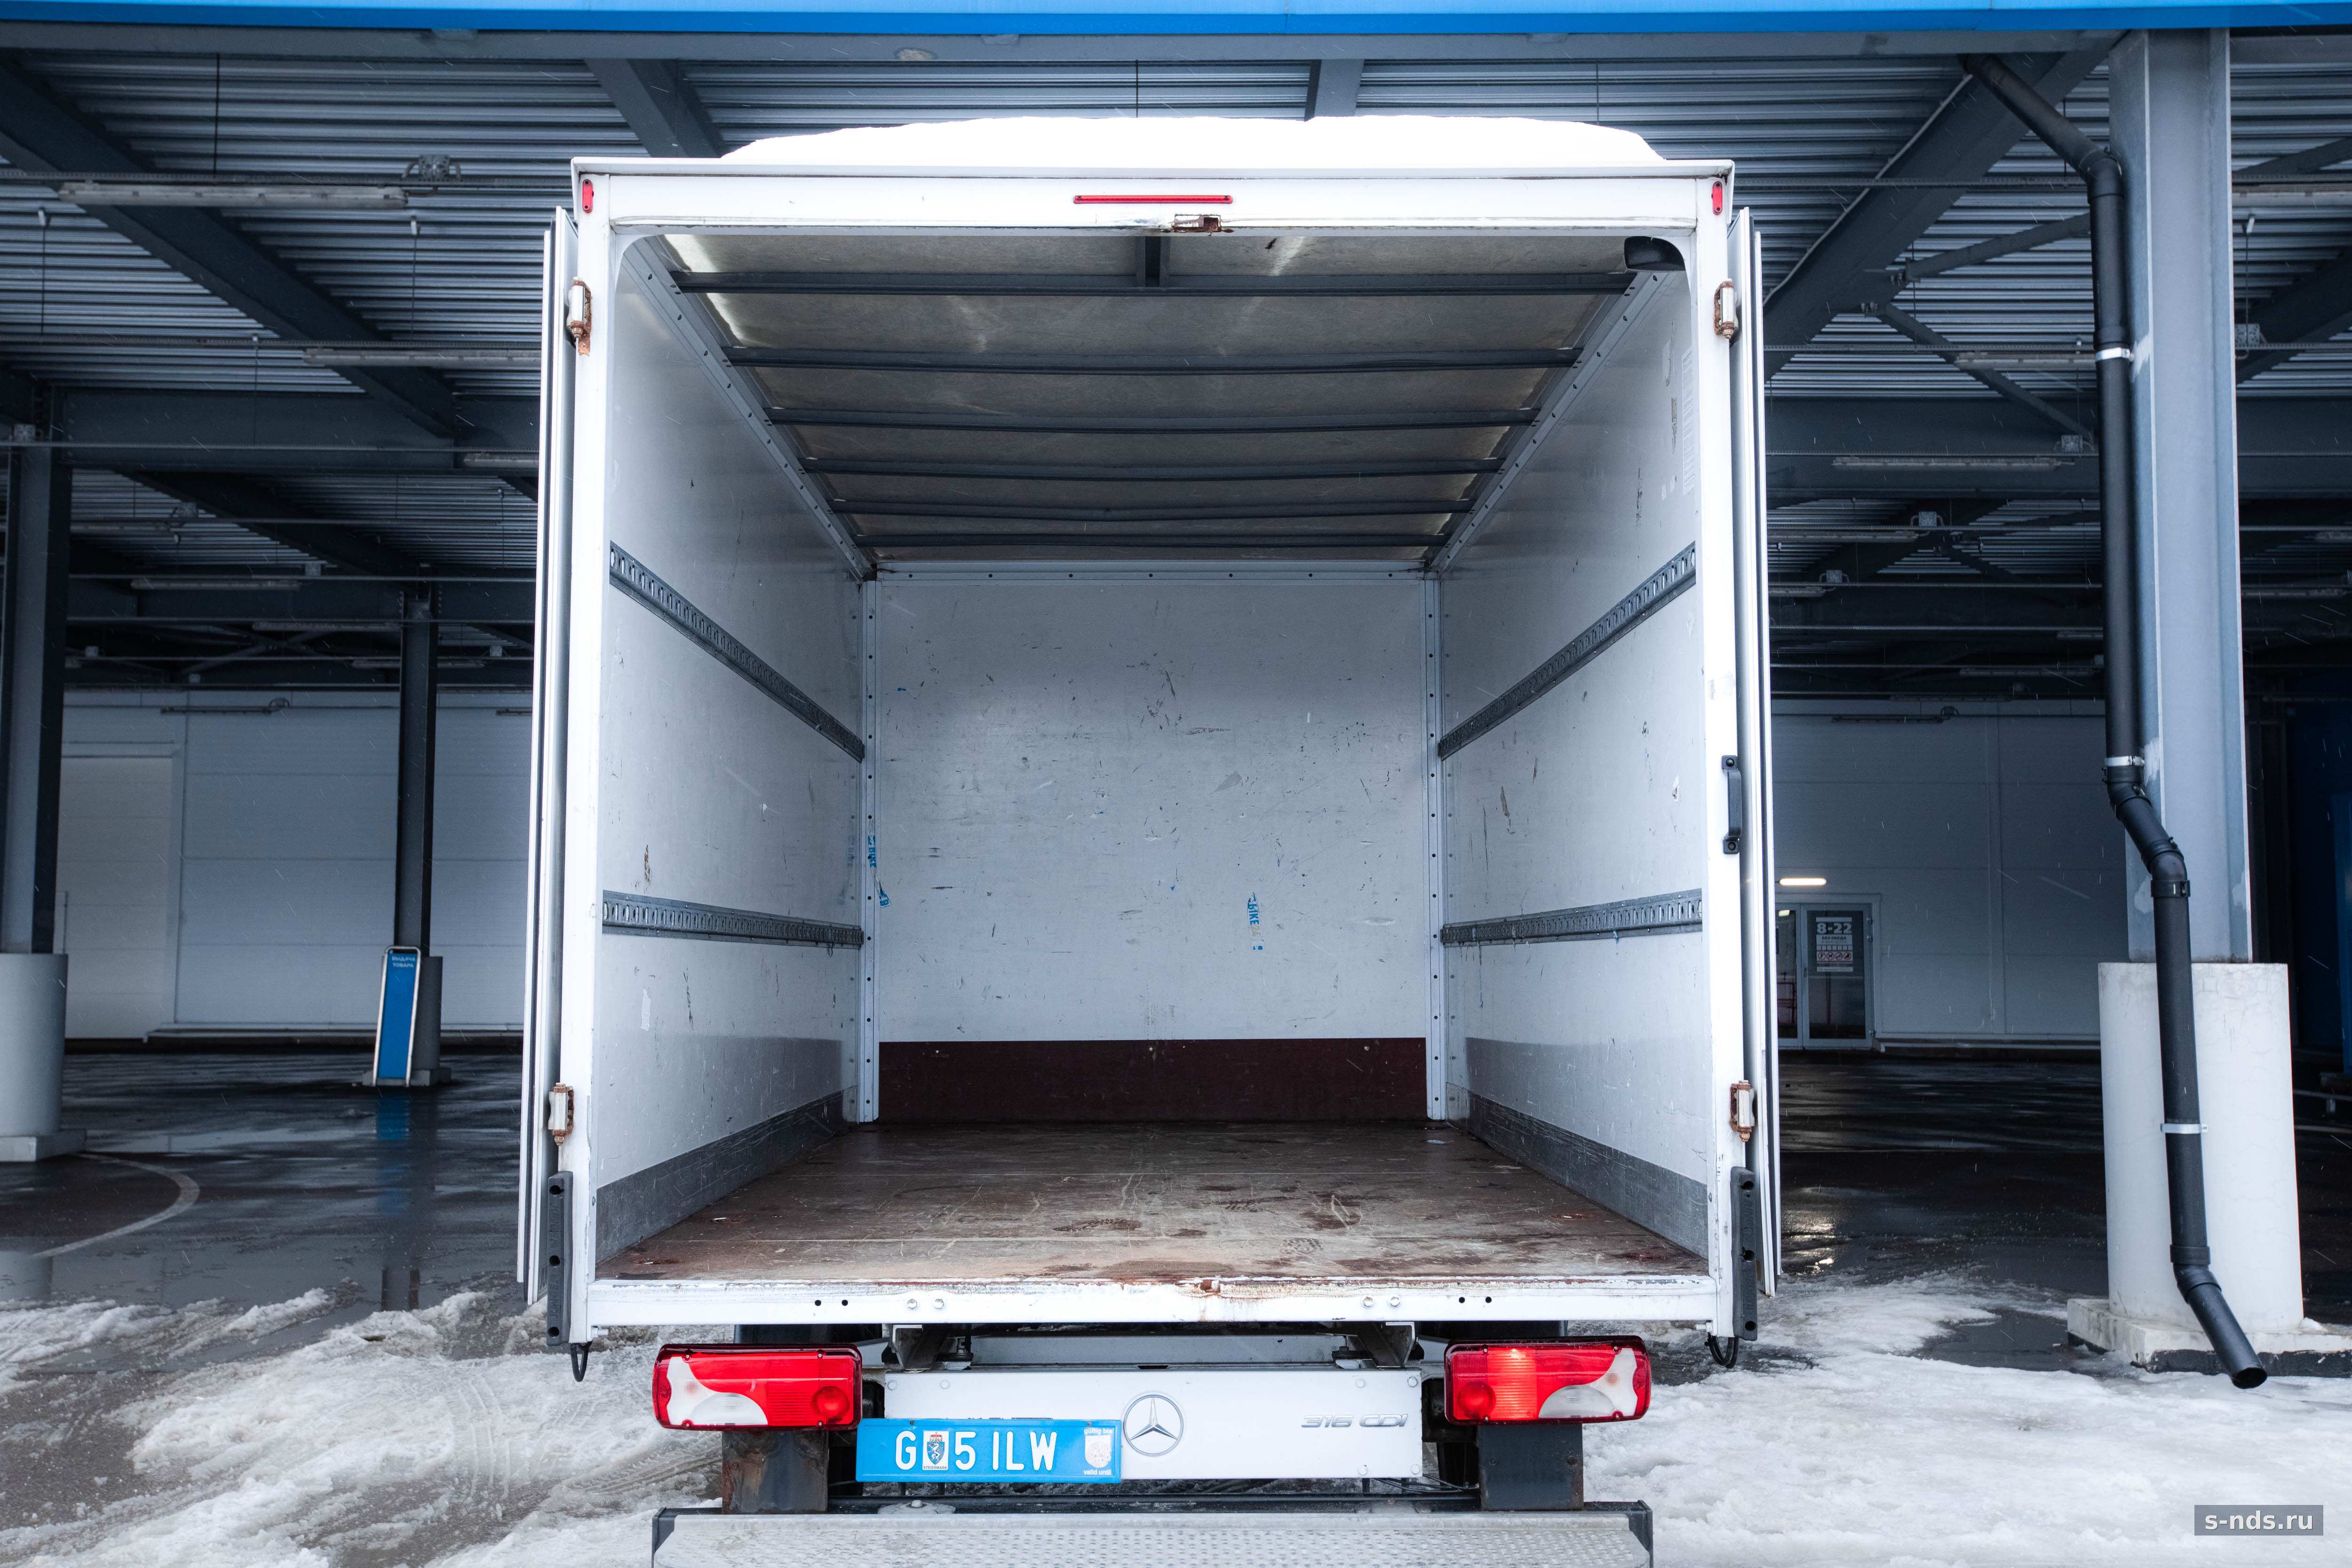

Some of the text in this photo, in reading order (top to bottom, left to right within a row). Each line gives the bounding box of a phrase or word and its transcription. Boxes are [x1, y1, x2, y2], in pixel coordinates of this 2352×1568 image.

[1816, 923, 1852, 934] 8-22
[1301, 1414, 1408, 1427] 316 CDI
[895, 1431, 916, 1471] G
[955, 1431, 976, 1471] 5
